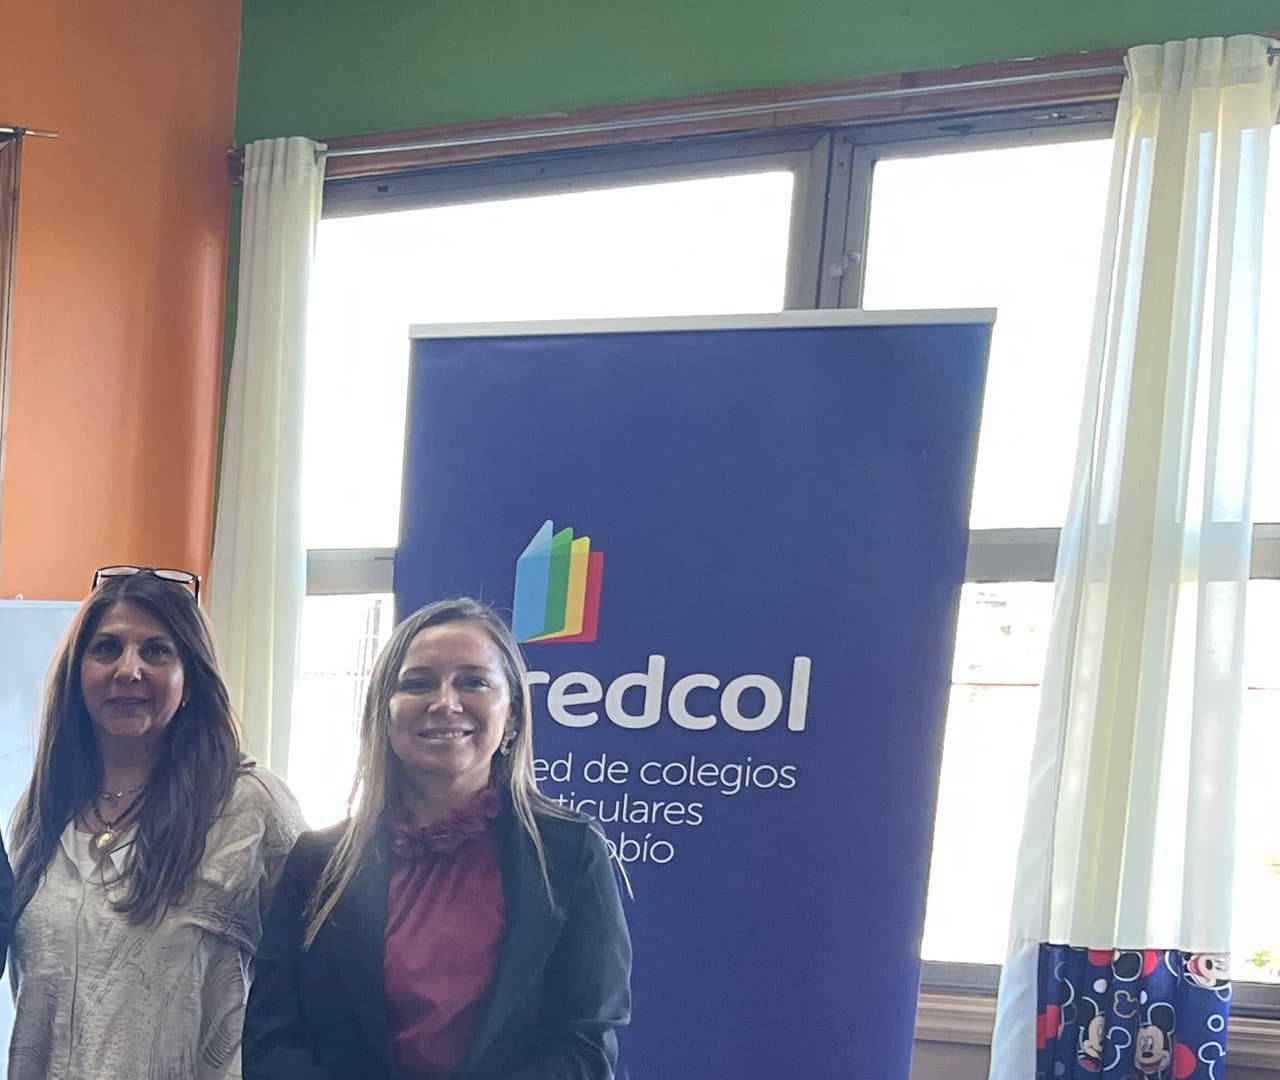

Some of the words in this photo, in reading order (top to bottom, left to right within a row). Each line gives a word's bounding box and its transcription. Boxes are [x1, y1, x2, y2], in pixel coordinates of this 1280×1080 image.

[533, 752, 573, 782] ed
[584, 753, 629, 784] de
[640, 755, 797, 795] colegios
[554, 791, 703, 826] ticulares
